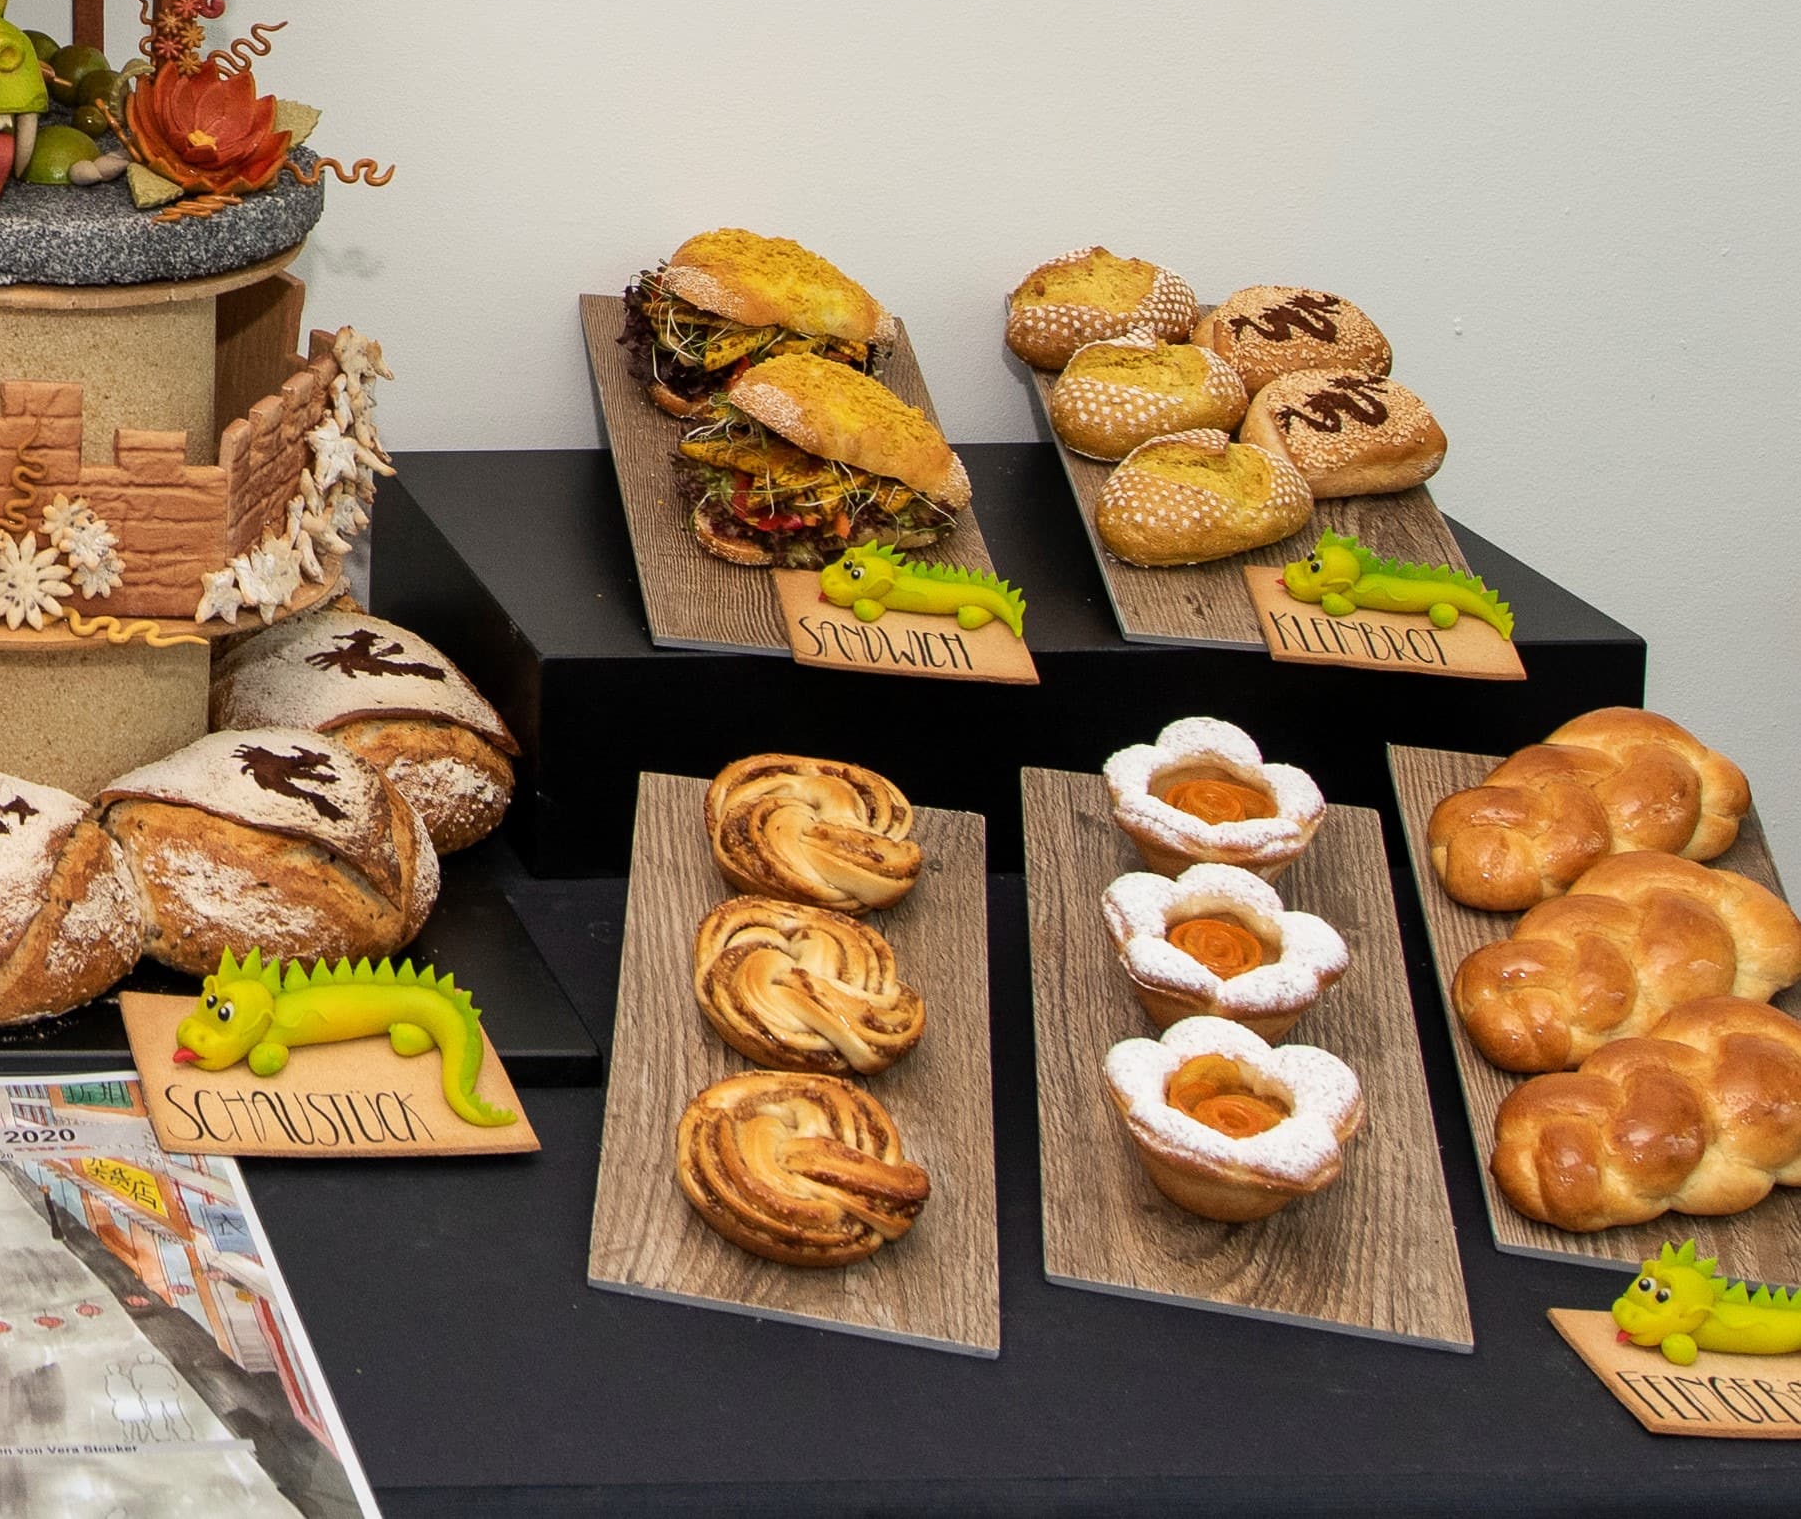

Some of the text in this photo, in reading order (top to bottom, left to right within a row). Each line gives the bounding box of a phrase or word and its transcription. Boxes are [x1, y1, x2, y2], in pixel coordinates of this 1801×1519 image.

[794, 616, 973, 671] SANDWICH
[1269, 610, 1448, 666] KLEINBROT
[4, 1127, 77, 1145] 2020
[165, 1084, 437, 1147] SCHAUSTÜCK
[1615, 1370, 1801, 1424] FEINGEB
[16, 1447, 43, 1455] von
[48, 1445, 79, 1455] Vera
